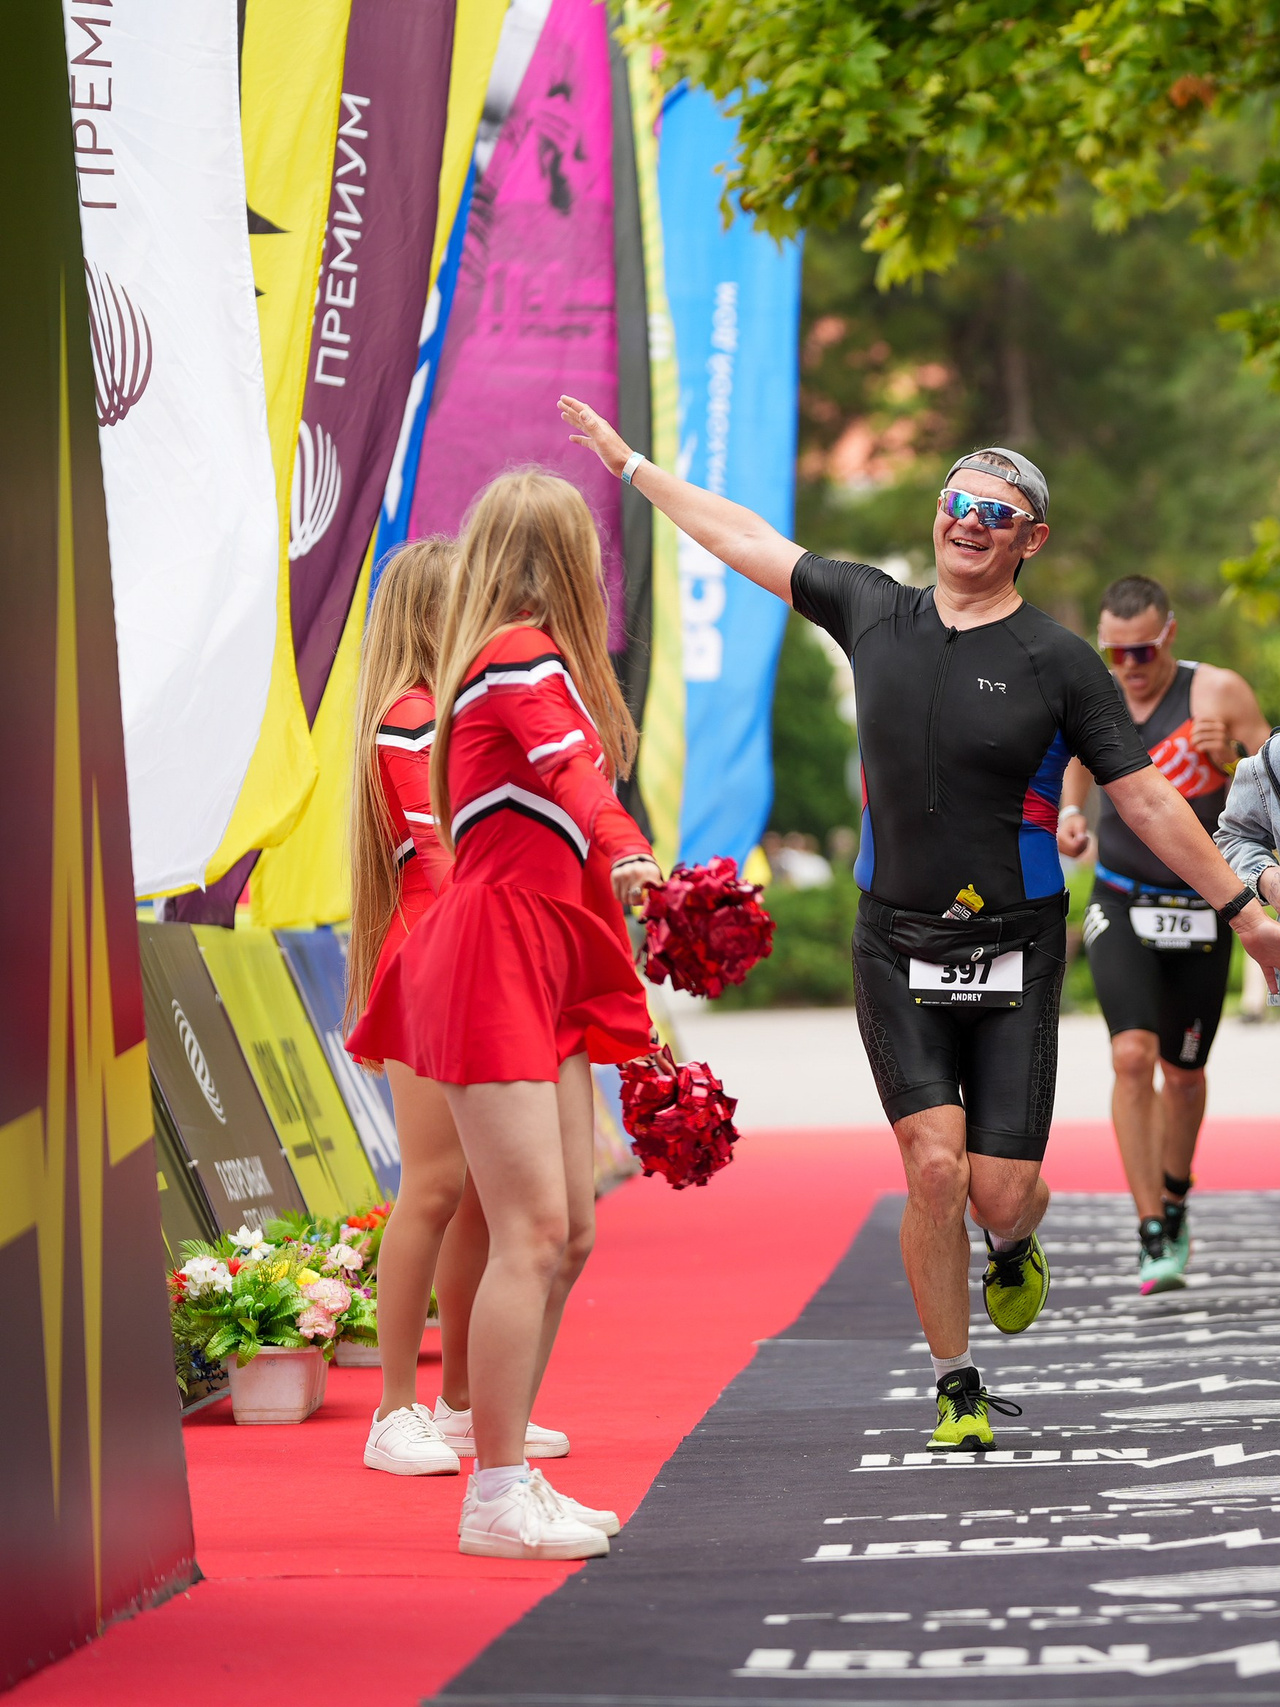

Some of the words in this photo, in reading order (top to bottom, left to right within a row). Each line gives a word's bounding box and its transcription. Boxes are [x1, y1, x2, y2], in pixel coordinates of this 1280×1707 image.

[70, 0, 117, 209] ПРЕМ
[314, 92, 371, 387] ПРЕМИУМ
[1154, 914, 1192, 933] 376
[940, 960, 993, 985] 397
[950, 992, 983, 1002] ANDREY
[859, 1447, 1151, 1467] IRON
[814, 1532, 1151, 1558] IRON
[743, 1643, 1151, 1670] IRON
